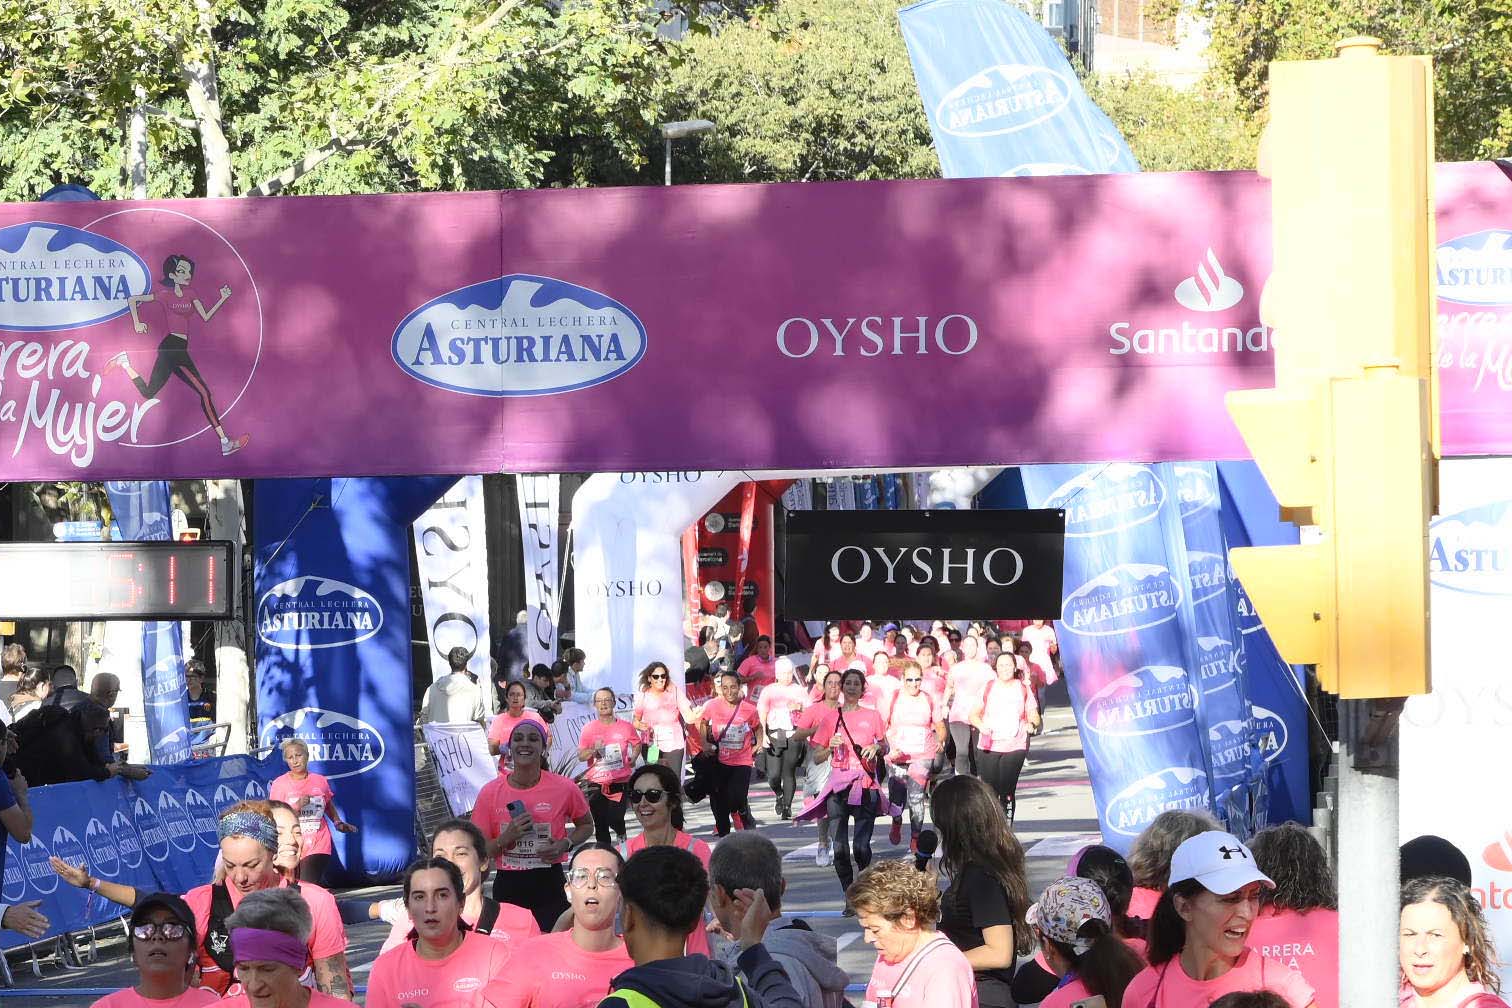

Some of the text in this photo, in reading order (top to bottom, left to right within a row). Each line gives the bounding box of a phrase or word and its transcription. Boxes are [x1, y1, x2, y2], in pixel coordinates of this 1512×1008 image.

[54, 258, 126, 270] LECHERA
[450, 314, 620, 330] CENTRAL LECHERA
[775, 313, 979, 358] OYSHO
[1109, 322, 1280, 355] Santand
[411, 322, 627, 367] ASTURIANA
[12, 374, 160, 468] Mujer
[620, 470, 701, 484] OYSHO
[831, 545, 1024, 587] OYSHO
[586, 579, 663, 598] OYSHO
[273, 600, 369, 610] CENTRAL LECHERA
[261, 606, 374, 633] ASTURIANA
[321, 732, 371, 741] LECHERA
[1252, 942, 1315, 957] RRERA
[398, 988, 429, 1001] OYSHO
